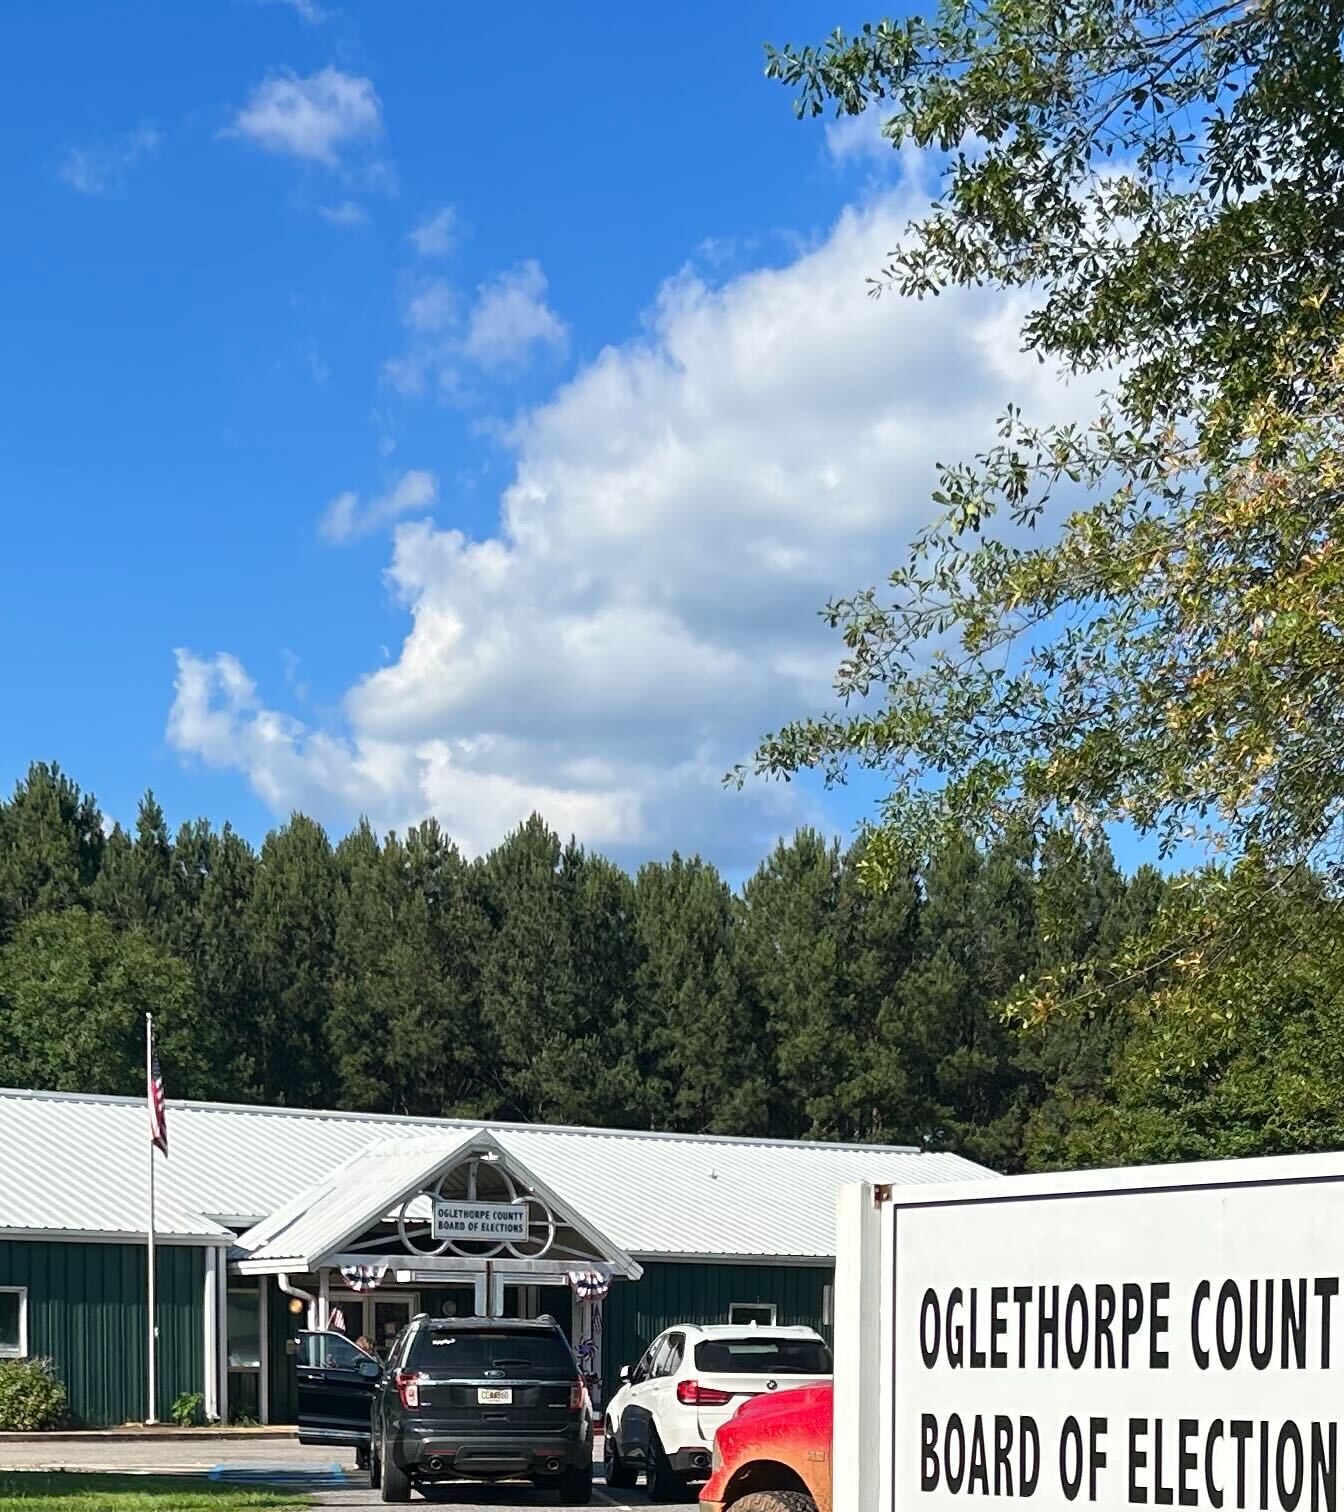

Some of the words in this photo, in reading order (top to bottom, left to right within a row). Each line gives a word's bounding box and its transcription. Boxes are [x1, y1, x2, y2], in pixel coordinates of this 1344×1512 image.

[438, 1209, 490, 1219] OGLETHORPE
[493, 1211, 524, 1220] COUNTY
[438, 1221, 465, 1231] BOARD
[468, 1222, 478, 1231] OF
[481, 1223, 523, 1233] ELECTIONS
[920, 1282, 1170, 1370] OGLETHORPE
[921, 1412, 1040, 1498] BOARD
[1059, 1415, 1108, 1501] OF
